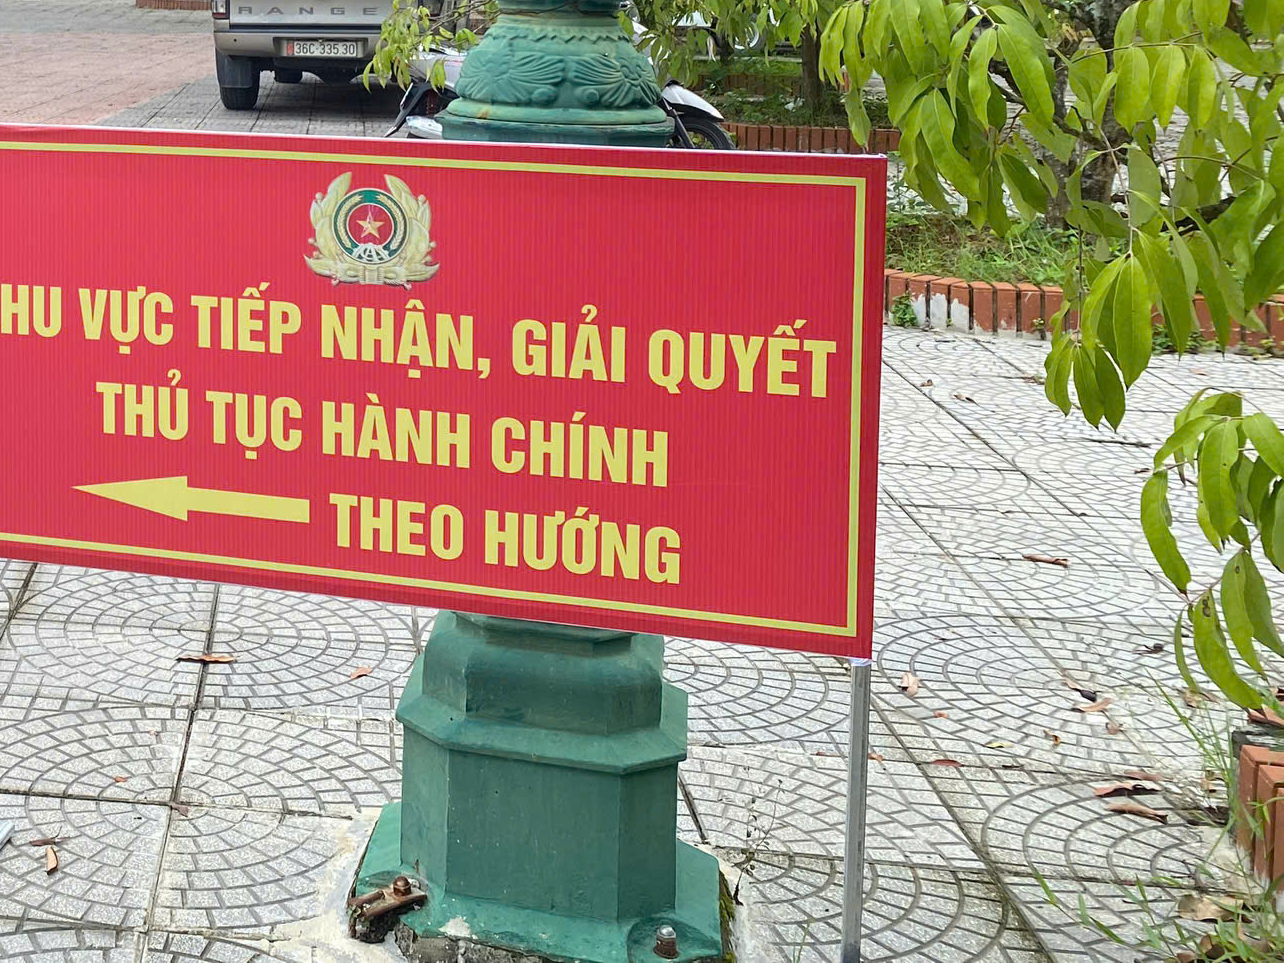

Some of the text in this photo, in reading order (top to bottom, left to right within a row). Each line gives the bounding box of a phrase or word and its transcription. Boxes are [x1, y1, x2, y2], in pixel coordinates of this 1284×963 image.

[238, 6, 406, 16] RANGE
[78, 285, 174, 355] VỰC
[190, 281, 302, 355] TIẾP
[321, 298, 491, 379] NHẬN,
[512, 304, 626, 383] GIẢI
[648, 319, 837, 398] QUYẾT
[95, 368, 669, 488] THỦ TỤC HÀNH CHÍNH
[329, 492, 681, 585] THEO HƯỚNG
